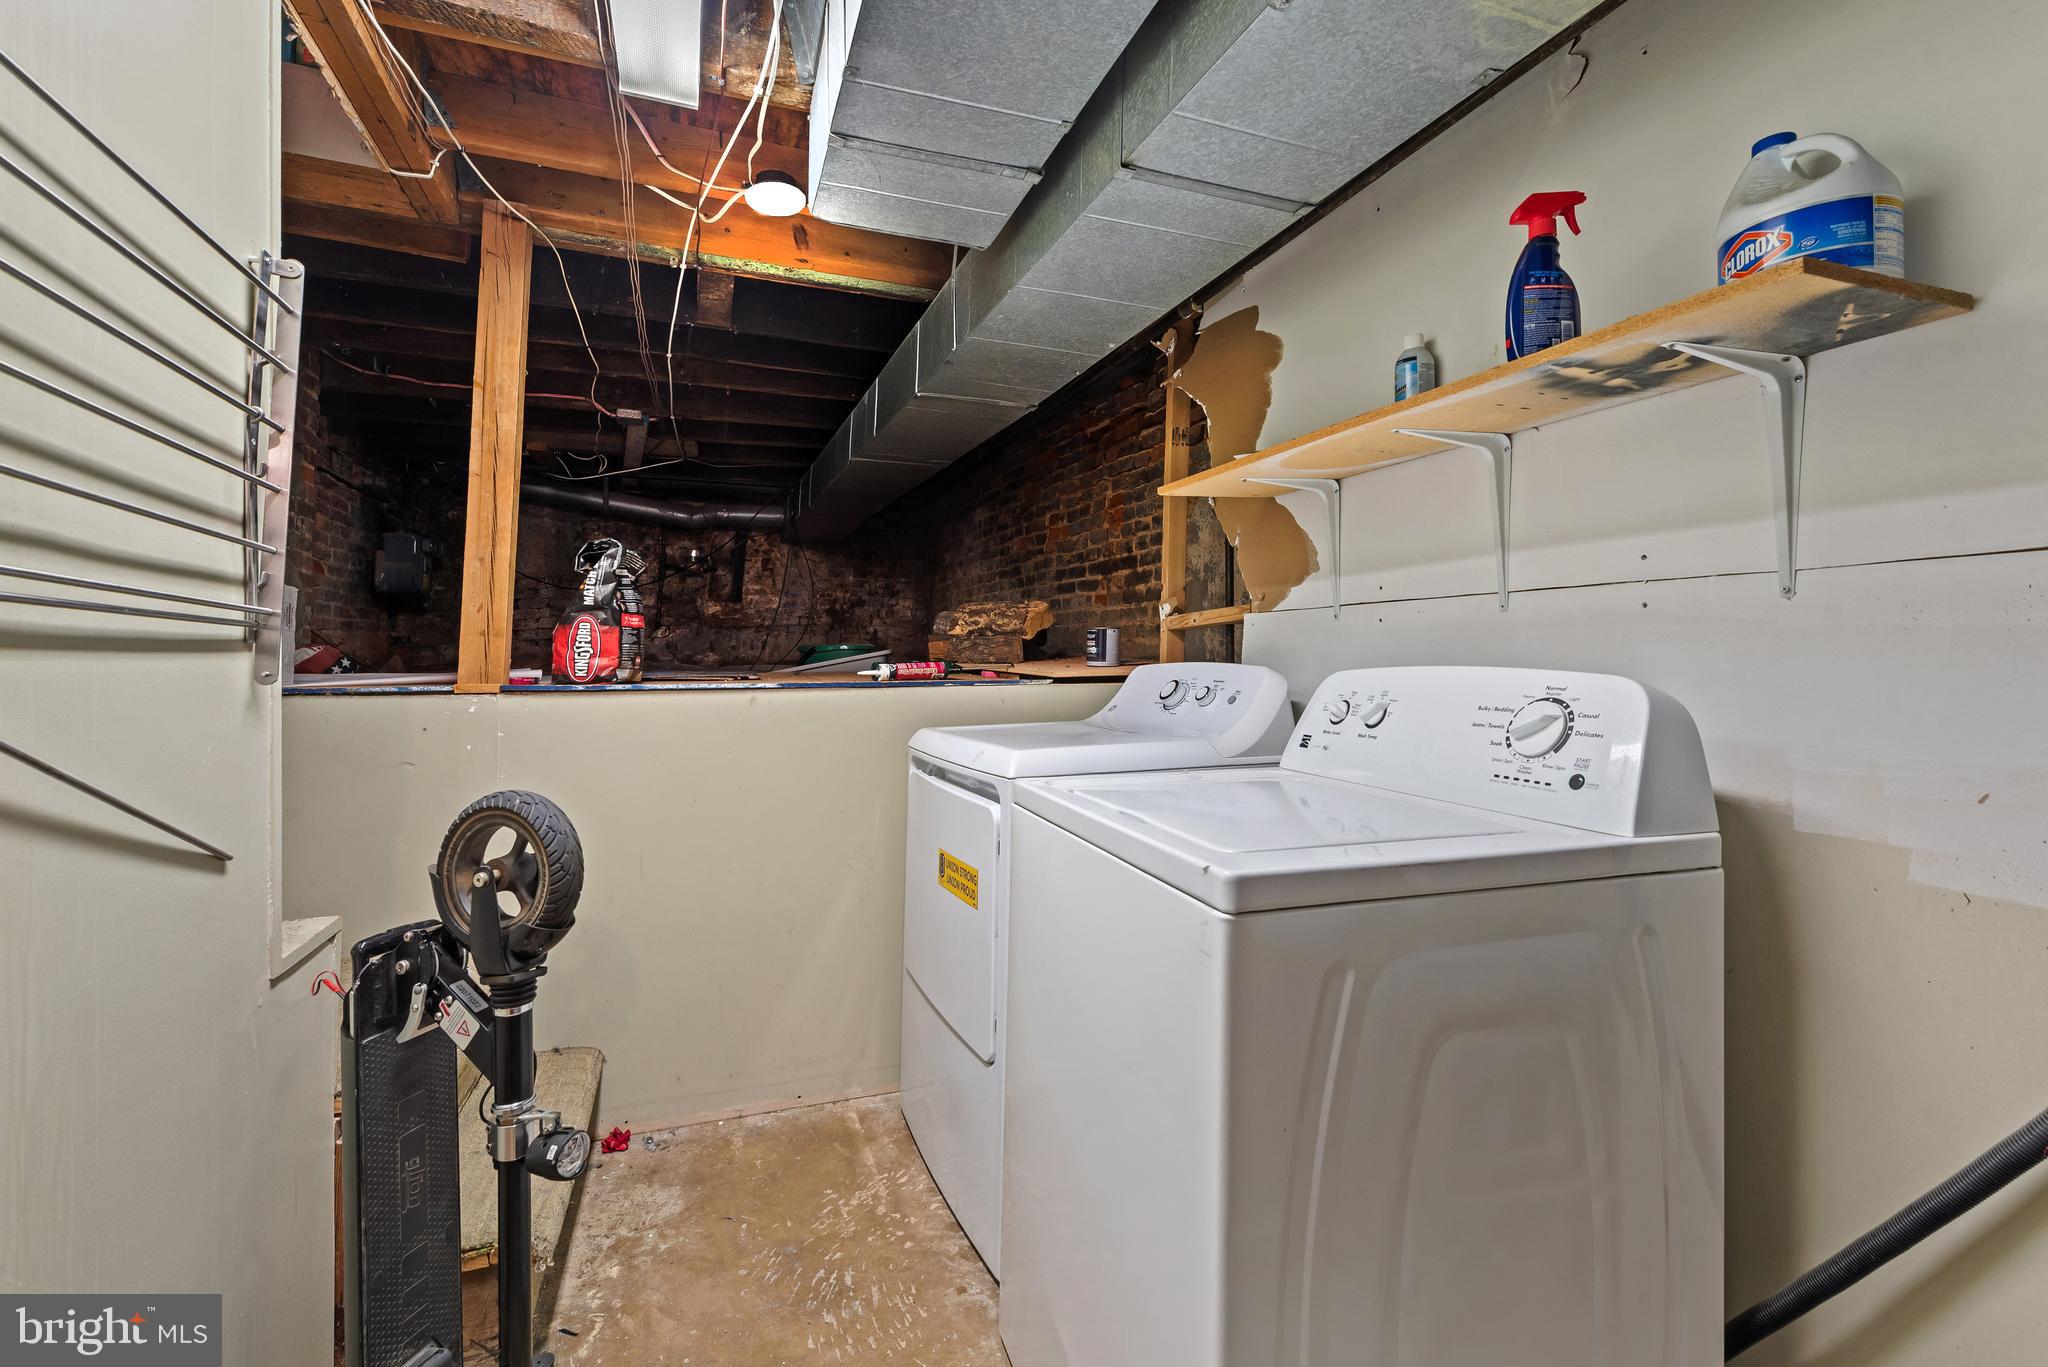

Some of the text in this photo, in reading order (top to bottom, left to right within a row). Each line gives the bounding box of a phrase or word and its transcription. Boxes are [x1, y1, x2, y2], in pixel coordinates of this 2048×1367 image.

[1725, 227, 1782, 280] CLOROX
[573, 622, 593, 677] KINGSFORD
[1575, 731, 1604, 739] Delicates
[946, 858, 977, 886] UNION STRONG
[946, 873, 976, 900] UNION PROUD
